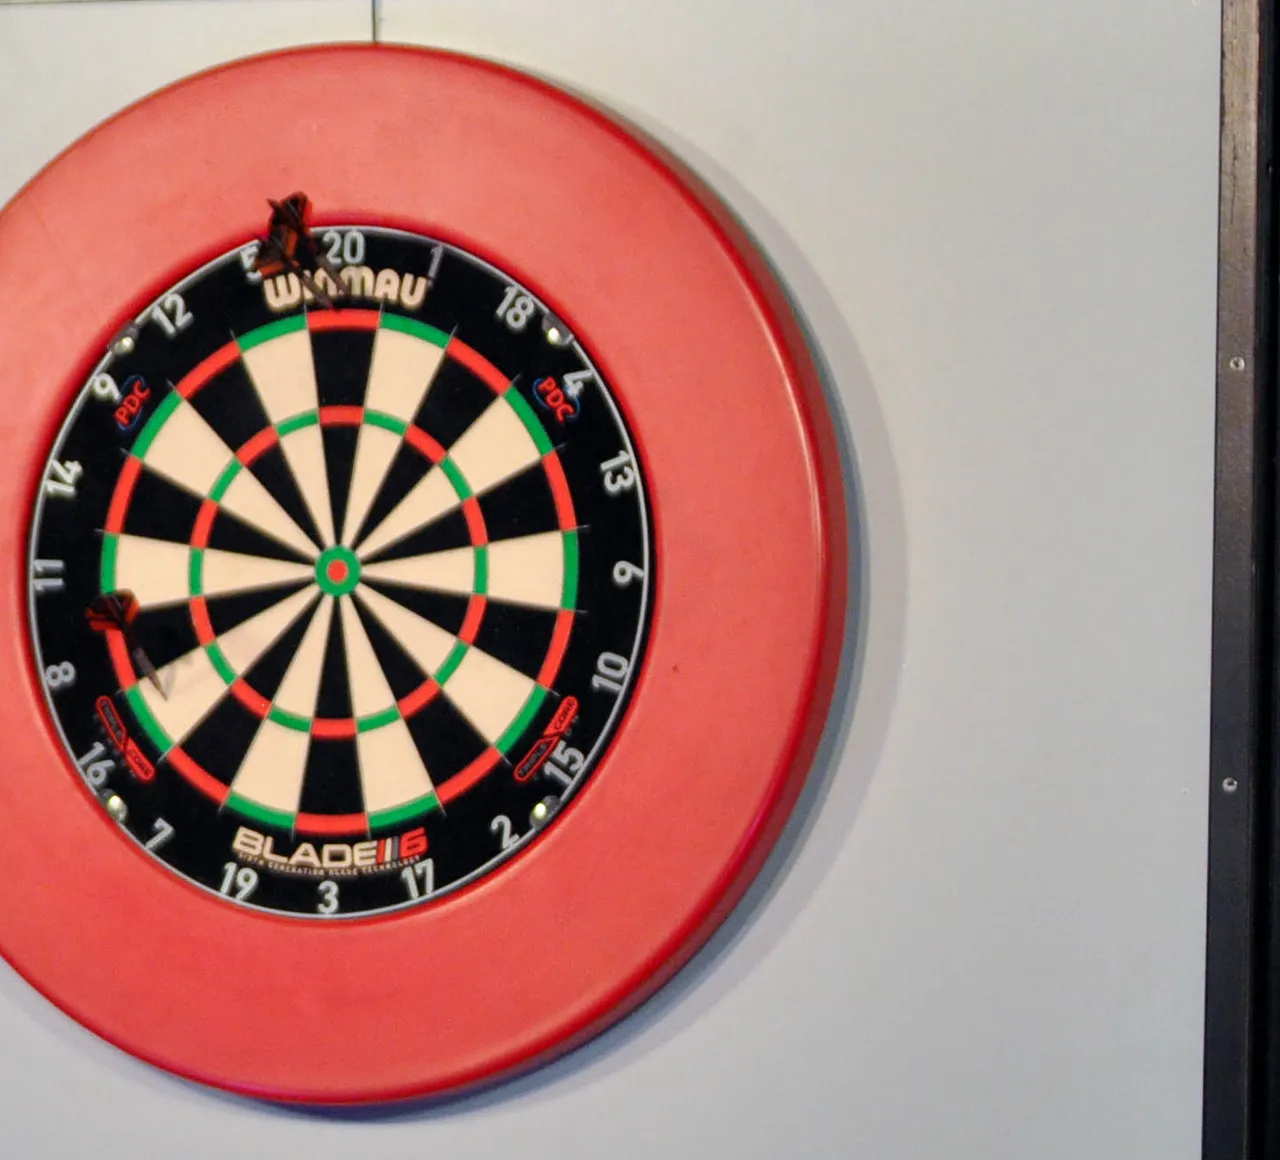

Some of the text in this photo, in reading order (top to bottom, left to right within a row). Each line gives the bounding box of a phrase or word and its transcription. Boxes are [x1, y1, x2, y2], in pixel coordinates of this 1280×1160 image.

[322, 230, 366, 264] 20
[428, 244, 444, 286] 1
[151, 293, 194, 337] 12
[495, 284, 535, 330] 18
[93, 372, 124, 404] 9
[113, 380, 151, 427] PDC
[536, 376, 575, 423] PDC
[562, 369, 593, 399] 4
[44, 459, 83, 497] 14
[599, 450, 635, 495] 13
[33, 558, 66, 591] 11
[613, 559, 644, 587] 9
[45, 661, 76, 689] 8
[592, 651, 630, 693] 10
[77, 741, 116, 786] 16
[544, 740, 585, 786] 15
[145, 817, 174, 850] 7
[232, 826, 377, 867] BLADE
[490, 814, 519, 849] 2
[220, 861, 258, 899] 19
[317, 880, 339, 914] 3
[400, 858, 435, 899] 17
